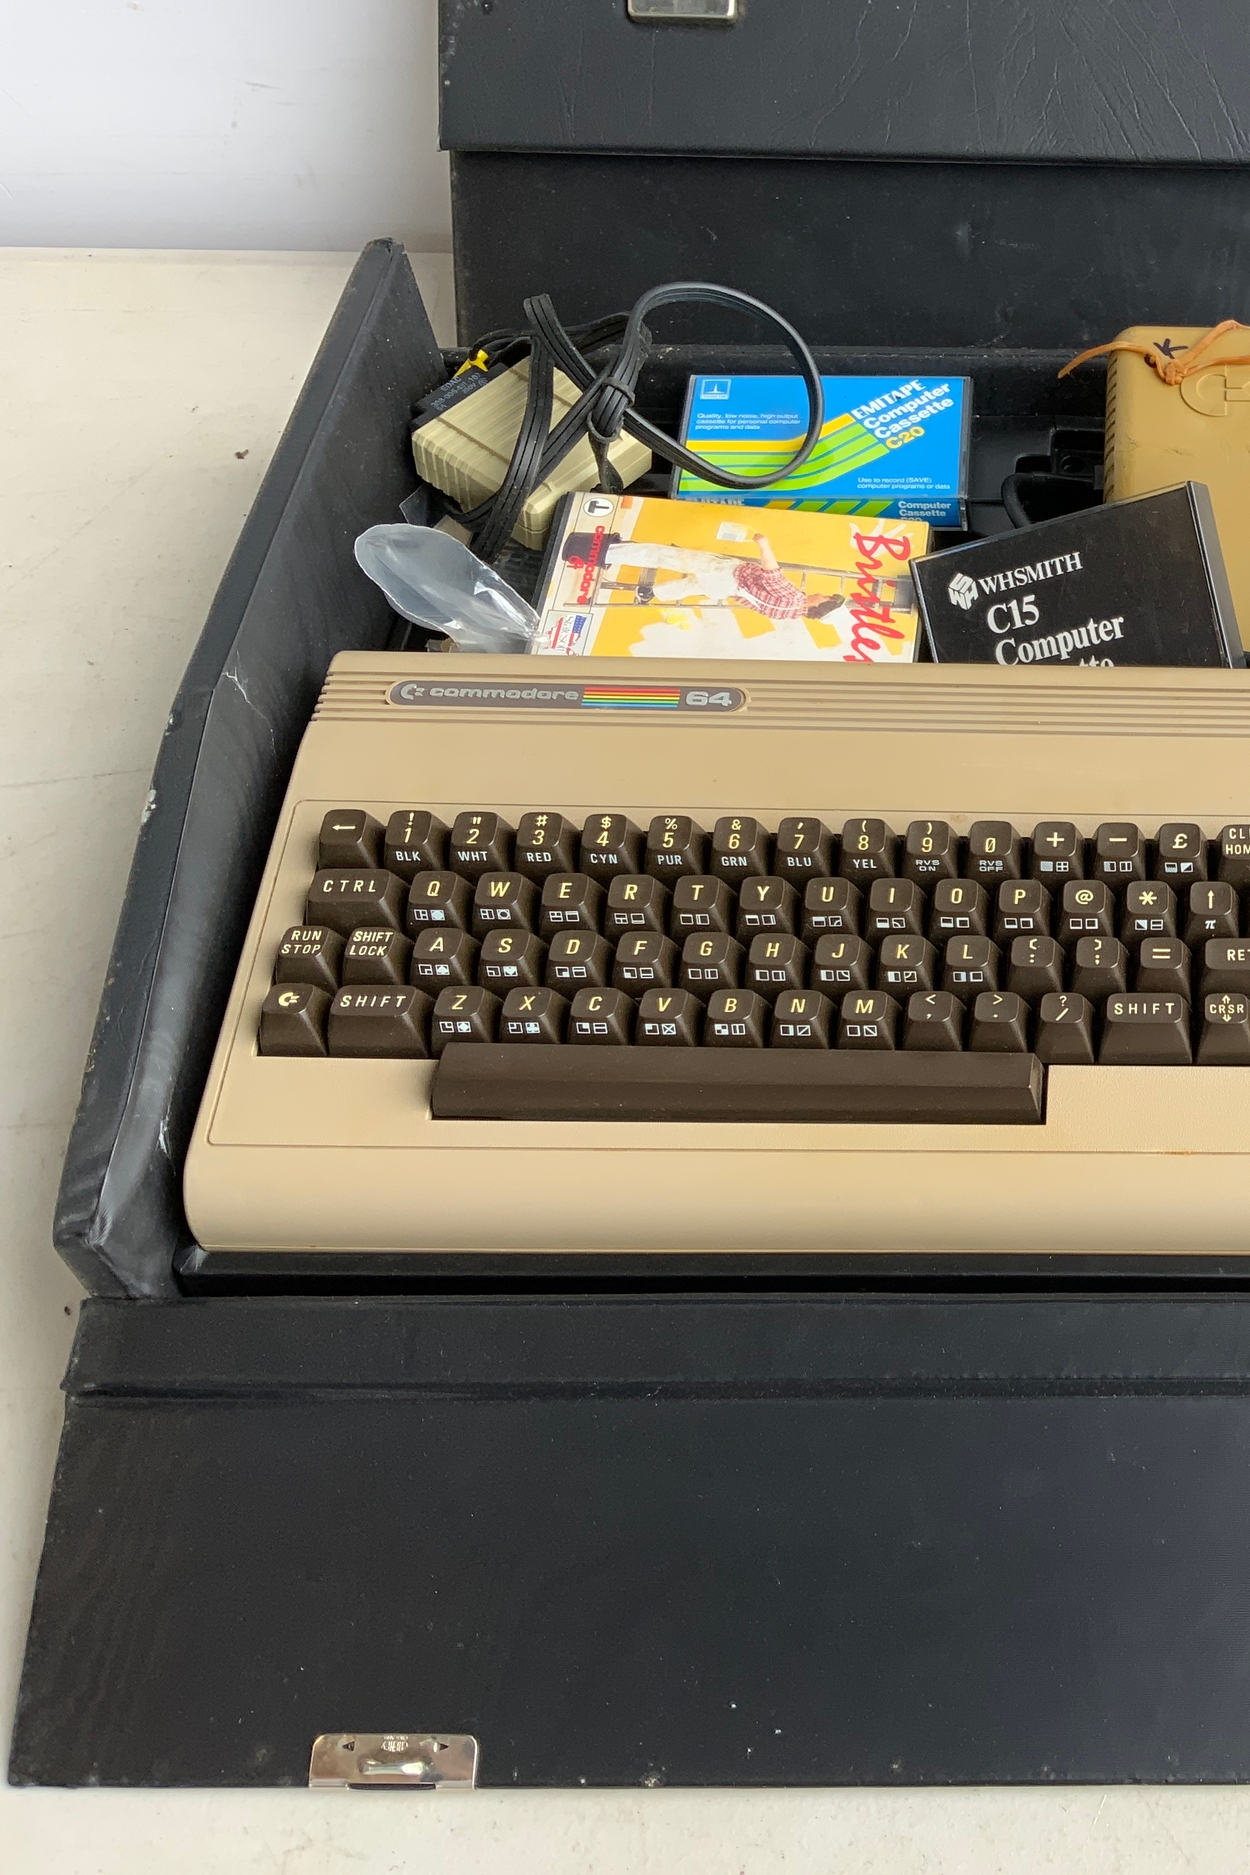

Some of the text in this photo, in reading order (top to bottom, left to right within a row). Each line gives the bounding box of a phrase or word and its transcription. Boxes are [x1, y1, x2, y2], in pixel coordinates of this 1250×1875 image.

[851, 379, 926, 420] EMITAPE
[863, 383, 950, 429] Computer
[874, 398, 954, 438] Cassette
[886, 426, 925, 449] C20
[898, 501, 952, 510] Computer
[899, 509, 946, 517] Cassette
[566, 556, 584, 570] 64
[577, 525, 605, 605] commodore
[978, 551, 1083, 596] WHSMITH
[987, 594, 1040, 634] C15
[995, 616, 1124, 666] Computer
[430, 687, 732, 708] commodore 64
[404, 828, 412, 843] 1
[466, 829, 479, 844] 2
[532, 830, 545, 845] 3
[596, 831, 609, 847] 4
[663, 832, 675, 848] 5
[728, 834, 740, 849] 6
[794, 835, 805, 849] 7
[858, 836, 869, 850] 8
[922, 837, 933, 853] 9
[395, 851, 421, 862] BLK
[457, 851, 488, 862] WHT
[526, 852, 552, 862] RED
[590, 854, 618, 865] CYN
[657, 855, 683, 865] PUR
[721, 856, 748, 867] GRN
[786, 857, 812, 867] BLU
[853, 858, 877, 869] YEL
[322, 880, 377, 893] CTRL
[426, 881, 441, 897] Q
[490, 881, 511, 897] W
[559, 882, 572, 899] E
[624, 884, 638, 900] R
[691, 885, 704, 900] T
[757, 886, 770, 901] Y
[821, 887, 834, 902] U
[951, 888, 963, 904] O
[1014, 889, 1026, 905] P
[1204, 920, 1216, 930] π
[290, 930, 322, 941] RUN
[352, 931, 393, 943] SHIFT
[281, 944, 321, 955] STOP
[349, 945, 387, 957] LOCK
[429, 936, 445, 952] A
[498, 938, 513, 953] S
[566, 939, 580, 954] D
[633, 940, 647, 956] F
[700, 941, 713, 957] G
[766, 942, 780, 958] H
[831, 943, 845, 958] J
[896, 944, 910, 959] K
[963, 944, 973, 959] L
[340, 995, 406, 1007] SHIFT
[452, 995, 468, 1010] Z
[519, 996, 536, 1011] X
[588, 996, 602, 1012] C
[658, 997, 672, 1013] V
[724, 998, 738, 1013] B
[791, 999, 806, 1013] N
[855, 999, 874, 1014] M
[1114, 1002, 1175, 1015] SHIFT
[1209, 1003, 1244, 1015] CRSR
